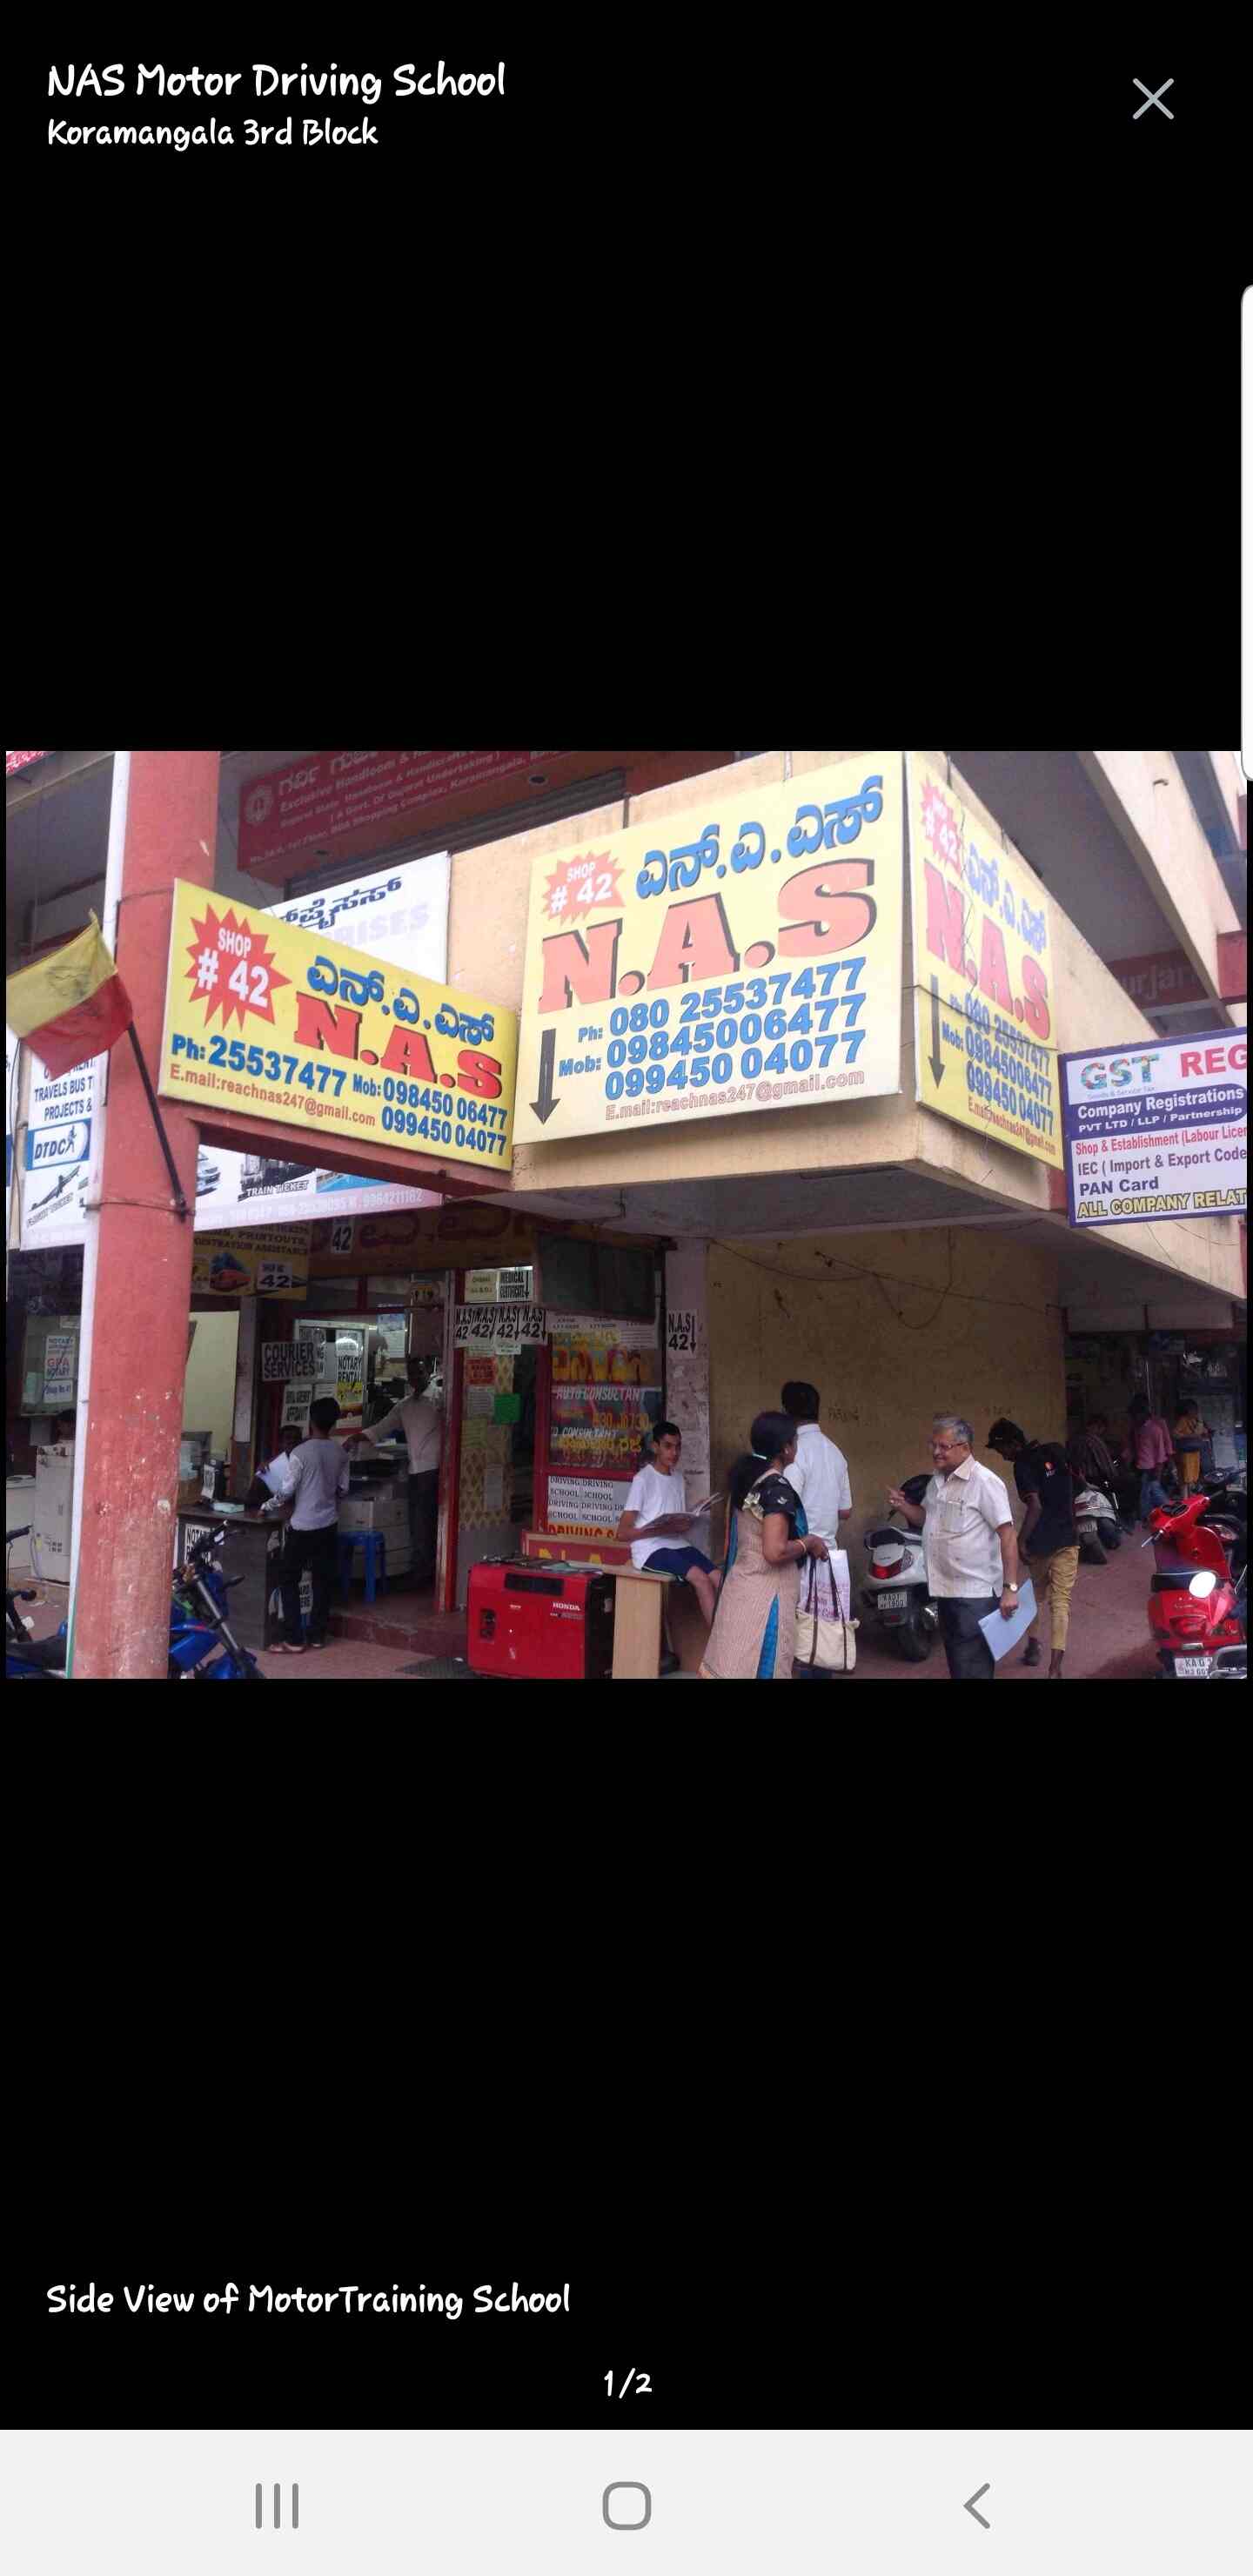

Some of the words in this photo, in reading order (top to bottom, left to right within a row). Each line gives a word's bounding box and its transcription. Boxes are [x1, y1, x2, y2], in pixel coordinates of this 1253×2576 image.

[566, 862, 597, 883] SHOP
[550, 886, 568, 914] #
[577, 873, 613, 904] 42
[218, 927, 251, 958] SHOP
[538, 857, 878, 1016] N.A.S
[924, 857, 1051, 1042] N.A.S
[198, 946, 219, 991] #
[228, 960, 270, 1009] 42
[579, 1025, 603, 1043] Ph:
[610, 999, 669, 1036] 080
[680, 956, 867, 1023] 25537477
[293, 990, 502, 1099] N.A.S
[559, 1055, 602, 1077] Mob:
[606, 993, 867, 1069] 09845006477
[605, 1053, 733, 1101] 099450
[740, 1030, 867, 1079] 04077
[1080, 1052, 1161, 1091] GST
[1180, 1043, 1247, 1078] REG
[34, 1083, 68, 1103] TRAVELS
[70, 1079, 85, 1095] BUS
[171, 1032, 205, 1061] Ph:
[208, 1034, 347, 1097] 25537477
[352, 1073, 382, 1097] Mob:
[383, 1077, 453, 1117] 098450
[457, 1097, 508, 1130] 06477
[966, 1060, 1017, 1117] 099450
[1018, 1092, 1055, 1137] 04077
[1077, 1101, 1142, 1120] Company
[1145, 1087, 1245, 1112] Registrations
[44, 1100, 84, 1122] PROJECTS
[86, 1098, 92, 1112] &
[1078, 1123, 1102, 1133] PVT
[1105, 1118, 1129, 1130] LTD
[1137, 1116, 1160, 1126] LLP
[1169, 1106, 1243, 1123] Partnership
[381, 1105, 452, 1144] 099450
[455, 1124, 507, 1157] 04077
[34, 1139, 66, 1160] DTDC
[1075, 1141, 1099, 1157] Shop
[1101, 1139, 1109, 1151] &
[1110, 1132, 1179, 1152] Establishment
[1182, 1129, 1219, 1147] (Labour
[1078, 1163, 1099, 1177] IEC
[1109, 1157, 1151, 1175] Import
[1155, 1154, 1164, 1169] &
[1168, 1149, 1211, 1170] Export
[1214, 1145, 1247, 1163] Code
[245, 1185, 272, 1197] TRAIN
[1079, 1180, 1114, 1197] PAN
[1119, 1177, 1160, 1193] Card
[1076, 1198, 1109, 1219] ALL
[1110, 1191, 1192, 1216] COMPANY
[1193, 1187, 1247, 1211] RELAT
[332, 1225, 352, 1252] 42
[260, 1273, 291, 1290] 42
[500, 1270, 525, 1284] MEDICAL
[498, 1306, 517, 1324] N.A.S
[522, 1307, 543, 1323] N.A.S
[668, 1312, 691, 1333] N.A.S
[456, 1325, 468, 1340] 42
[471, 1325, 490, 1338] 42
[497, 1324, 513, 1338] 42
[521, 1323, 540, 1338] 42
[264, 1343, 314, 1365] COURIER
[667, 1334, 689, 1352] 42
[264, 1361, 316, 1379] SERVICES
[338, 1356, 363, 1372] NOTARY
[550, 1475, 580, 1487] DRIVING
[582, 1478, 613, 1489] DRIVING
[550, 1488, 580, 1498] SCHOOL
[548, 1499, 580, 1509] DRIVING
[581, 1502, 613, 1512] DRIVING
[583, 1513, 613, 1523] SCHOOL
[552, 1600, 581, 1612] HONDA
